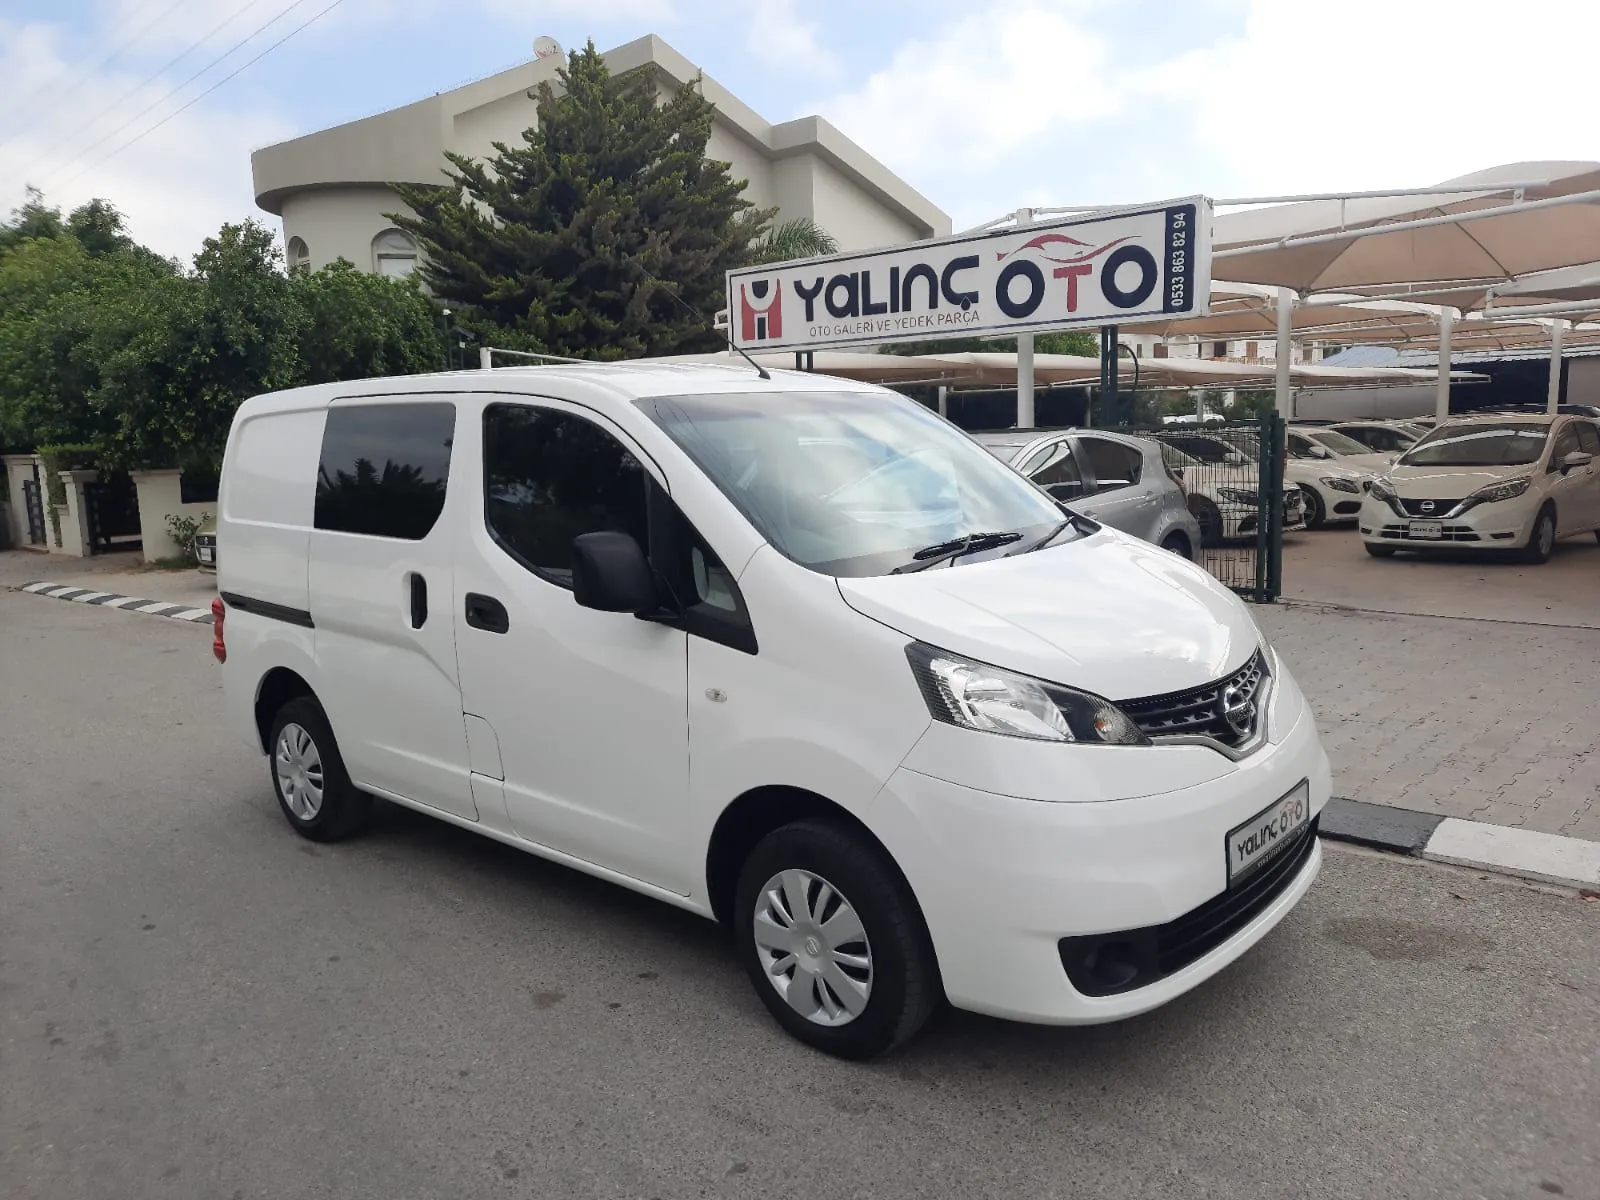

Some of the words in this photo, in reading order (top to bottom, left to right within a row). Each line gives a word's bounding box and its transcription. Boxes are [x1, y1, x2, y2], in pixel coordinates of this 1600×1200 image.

[1173, 212, 1187, 229] 94
[1172, 231, 1186, 247] 82
[1171, 250, 1185, 273] 863
[995, 244, 1158, 319] OTO
[1170, 276, 1185, 307] 0533
[809, 325, 831, 338] OTO
[834, 319, 874, 336] GALERİ
[876, 319, 891, 332] VE
[894, 315, 933, 330] YEDEK
[937, 310, 980, 326] PARÇA
